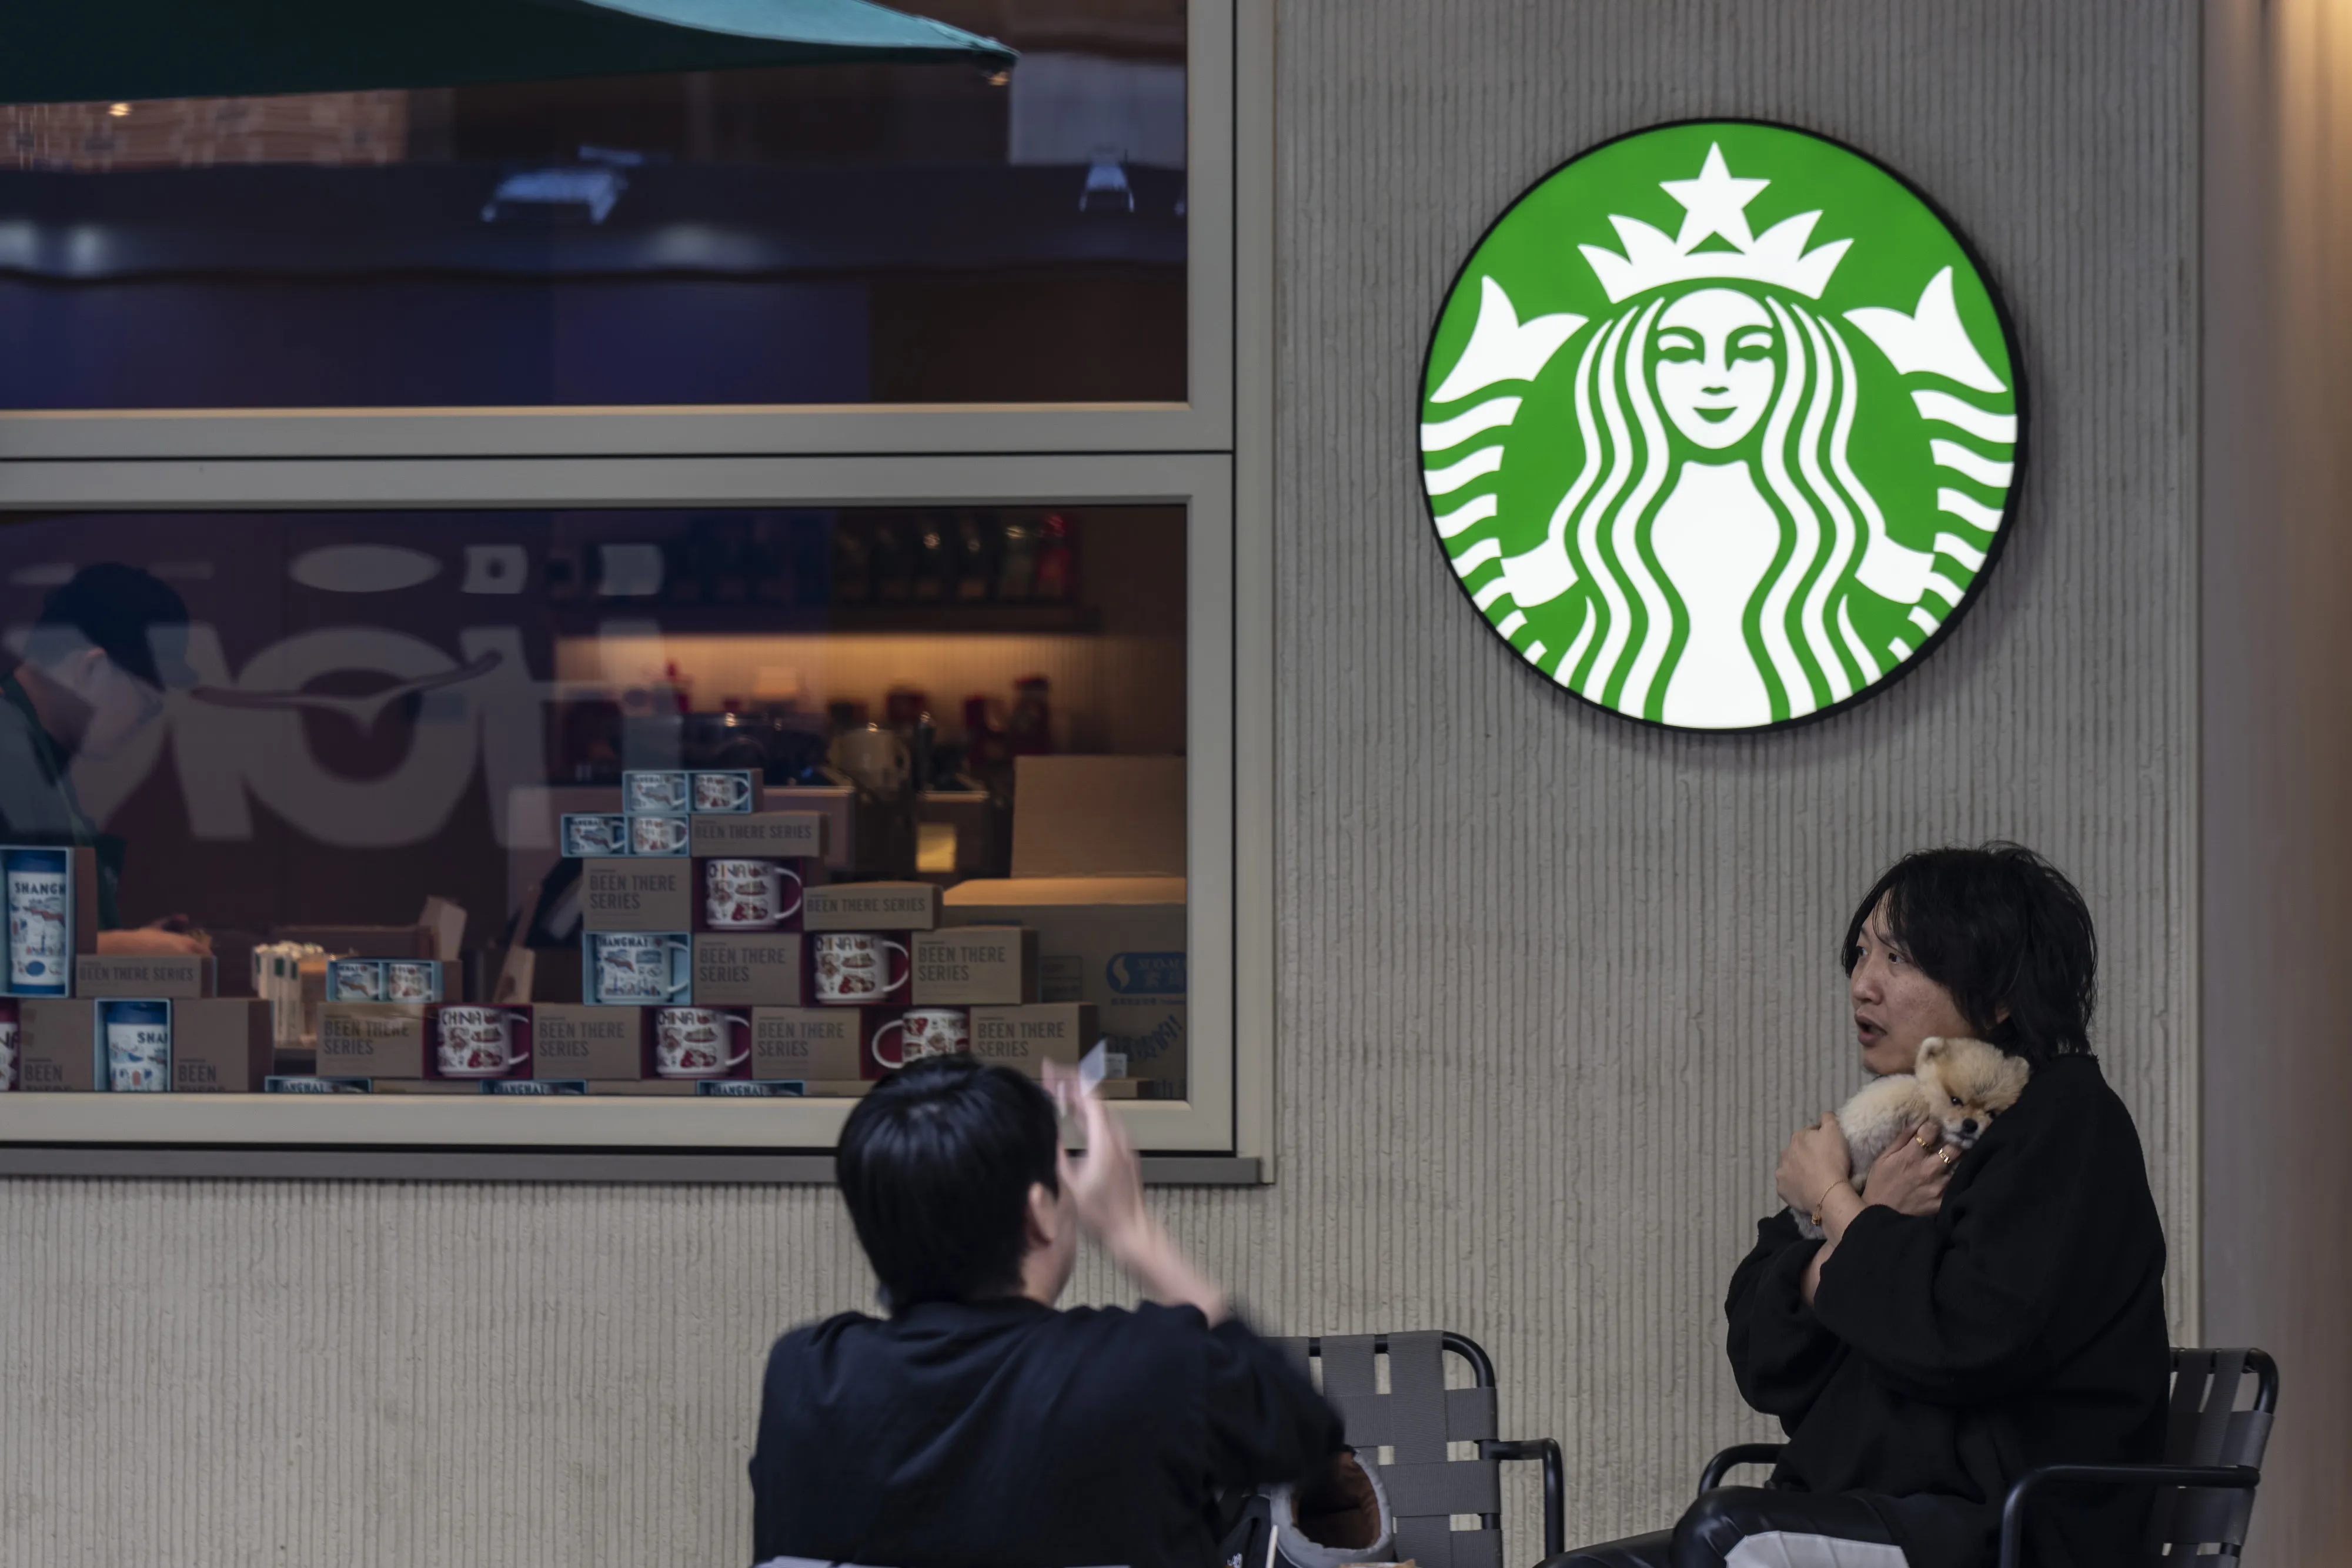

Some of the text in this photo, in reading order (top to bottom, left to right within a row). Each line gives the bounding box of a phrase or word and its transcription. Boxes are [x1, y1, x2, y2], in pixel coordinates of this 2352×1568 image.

[694, 825, 811, 838] BEEN THERE SERIES
[590, 875, 676, 891] BEEN THERE
[590, 894, 640, 910] SERIES
[807, 899, 926, 912] BEEN THERE SERIES
[700, 948, 786, 964] BEEN THERE
[918, 947, 1005, 962] BEEN THERE
[79, 967, 193, 981] BEEN THERE SERIES
[700, 967, 750, 982] SERIES
[918, 966, 969, 982] SERIES
[324, 1021, 363, 1037] BEEN
[539, 1022, 624, 1038] BEEN THERE
[758, 1022, 845, 1038] BEEN THERE
[977, 1022, 1065, 1039] BEEN THERE
[324, 1039, 375, 1055] SERIES
[539, 1041, 589, 1057] SERIES
[758, 1041, 808, 1057] SERIES
[977, 1041, 1029, 1058] SERIES
[24, 1065, 62, 1082] BEEN
[178, 1065, 216, 1082] BEEN
